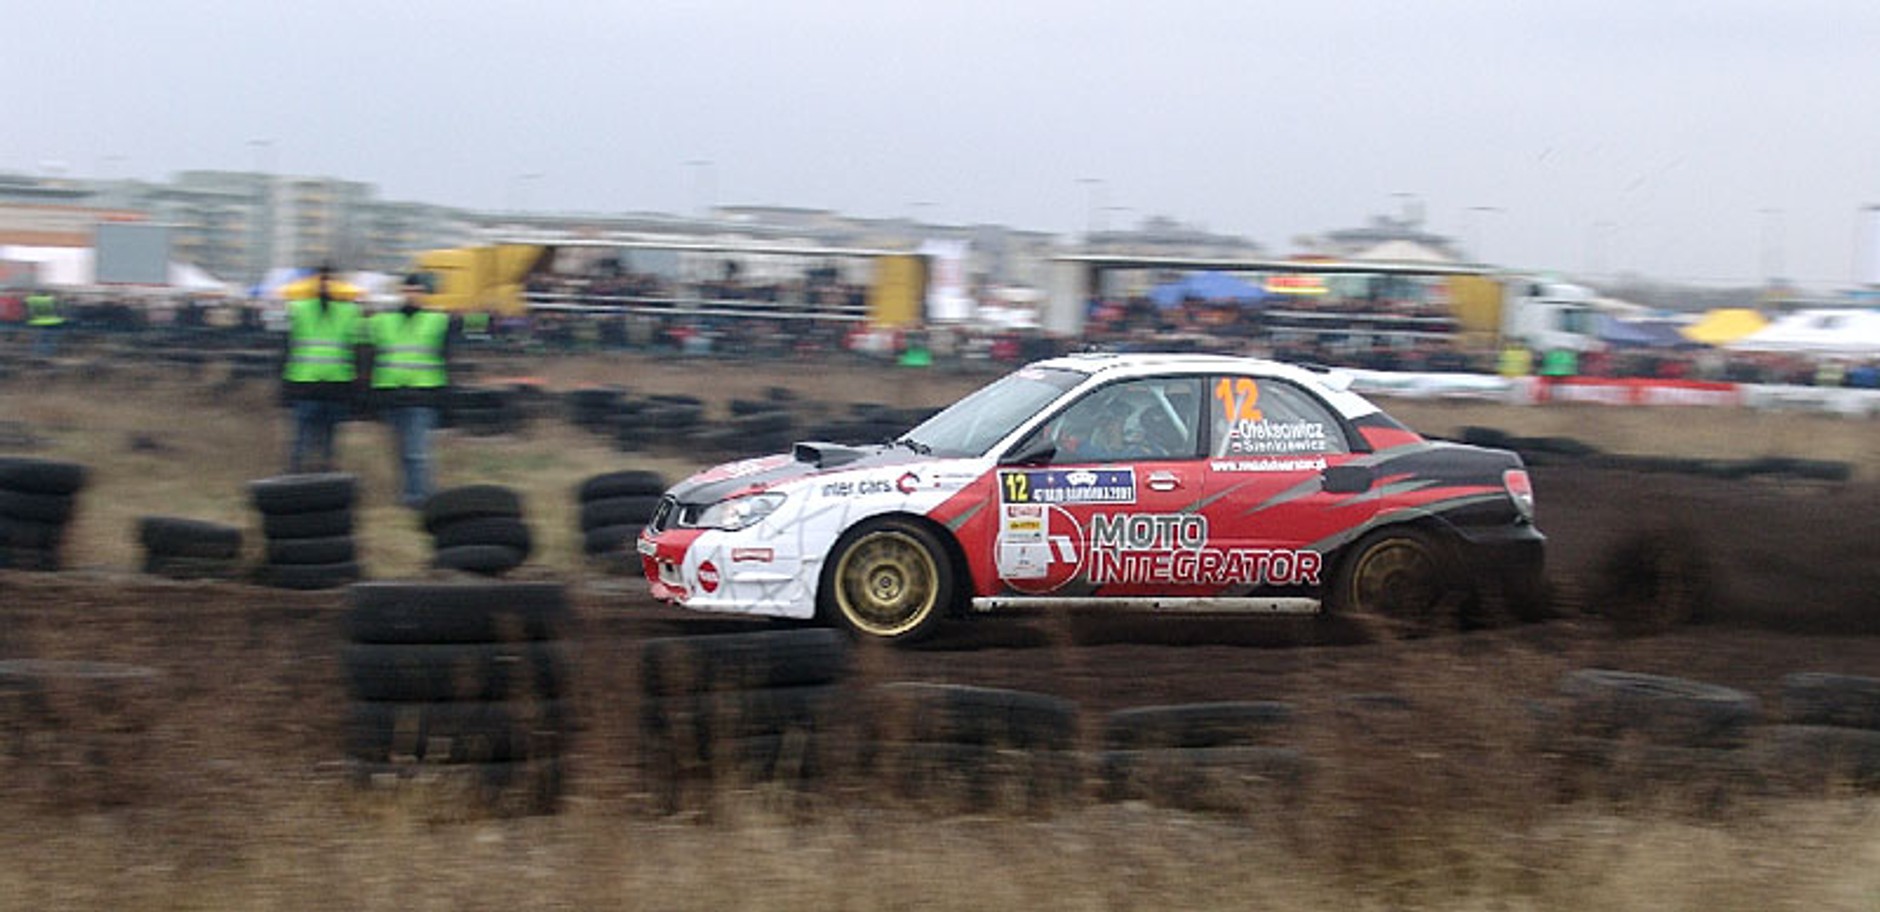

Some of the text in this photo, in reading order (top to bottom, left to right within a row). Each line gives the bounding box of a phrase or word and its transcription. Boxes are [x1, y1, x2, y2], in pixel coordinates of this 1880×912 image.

[1215, 377, 1263, 422] 12
[1006, 474, 1028, 501] 12
[1092, 513, 1207, 549] MOTO
[1089, 551, 1322, 585] INTEGRATOR
